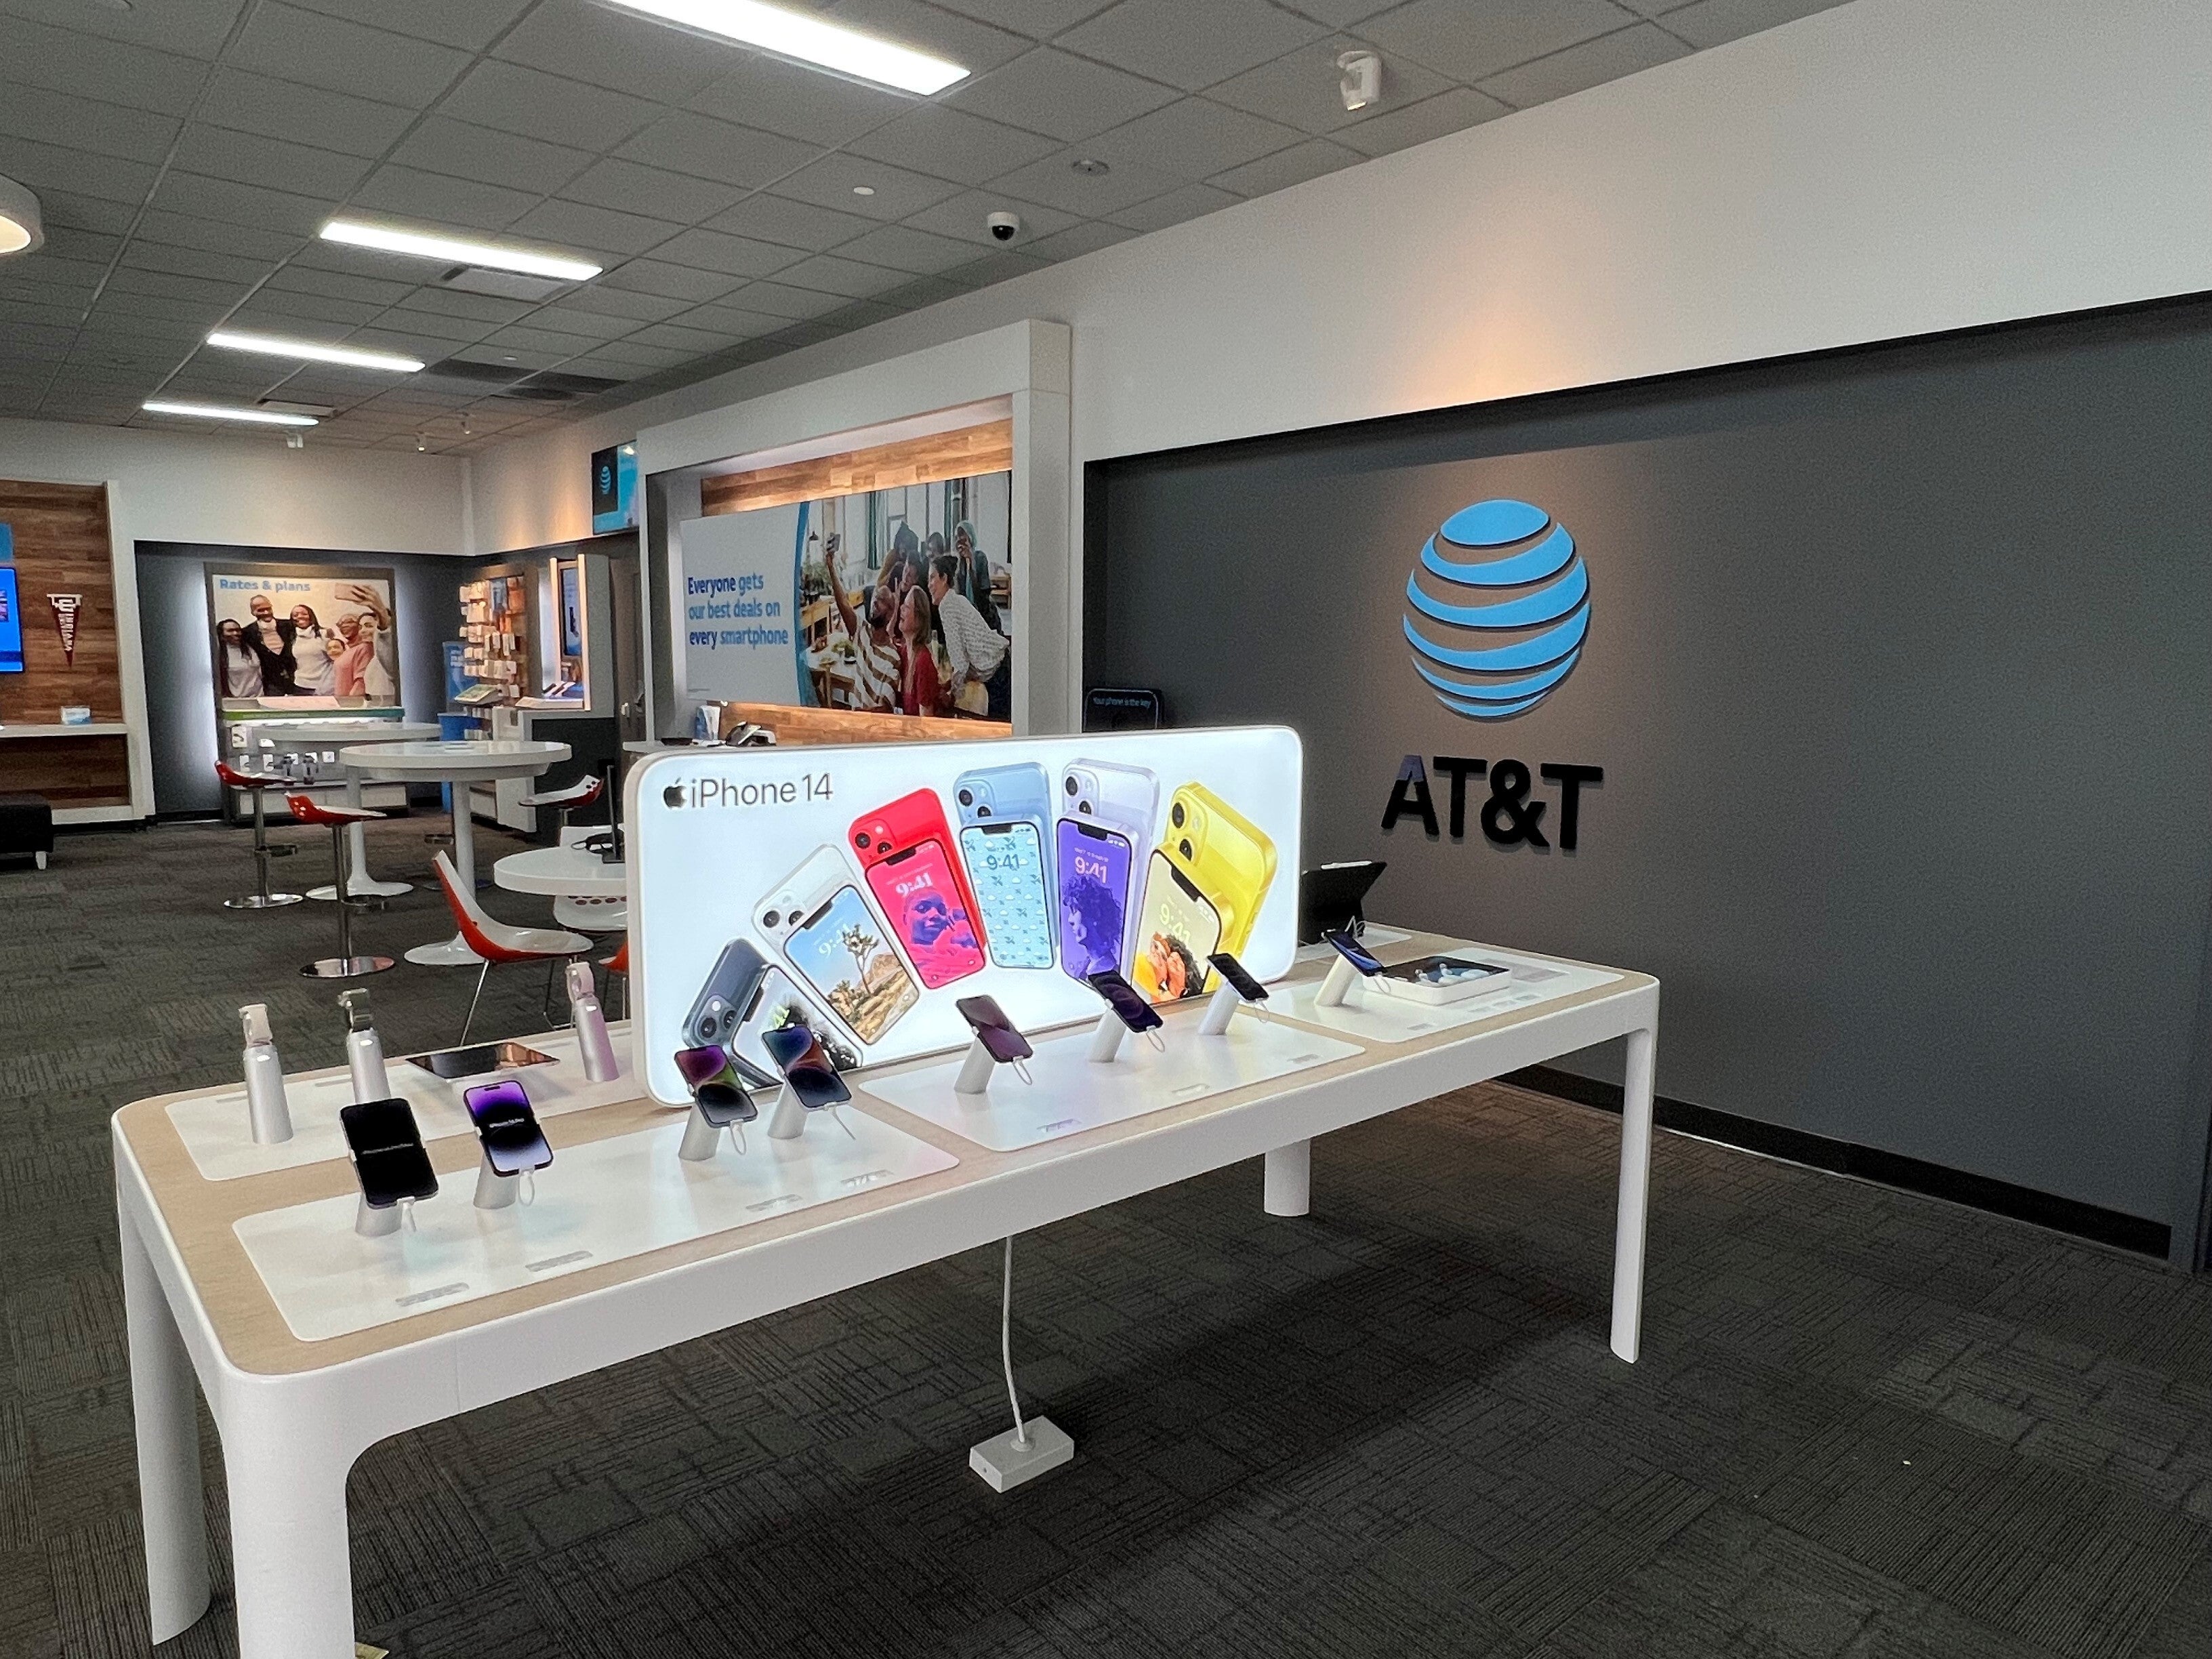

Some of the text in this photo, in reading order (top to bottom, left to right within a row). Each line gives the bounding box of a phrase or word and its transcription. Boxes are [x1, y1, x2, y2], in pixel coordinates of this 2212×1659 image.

[220, 579, 310, 592] Rates & plans
[688, 571, 764, 598] Everyone gets
[689, 598, 781, 619] our best deals on
[689, 624, 789, 650] every smartphone
[691, 773, 834, 808] iPhone 14
[1381, 755, 1603, 850] AT&T
[987, 853, 1020, 870] 9:41
[1074, 856, 1108, 884] 9:41
[895, 872, 933, 897] 9:41
